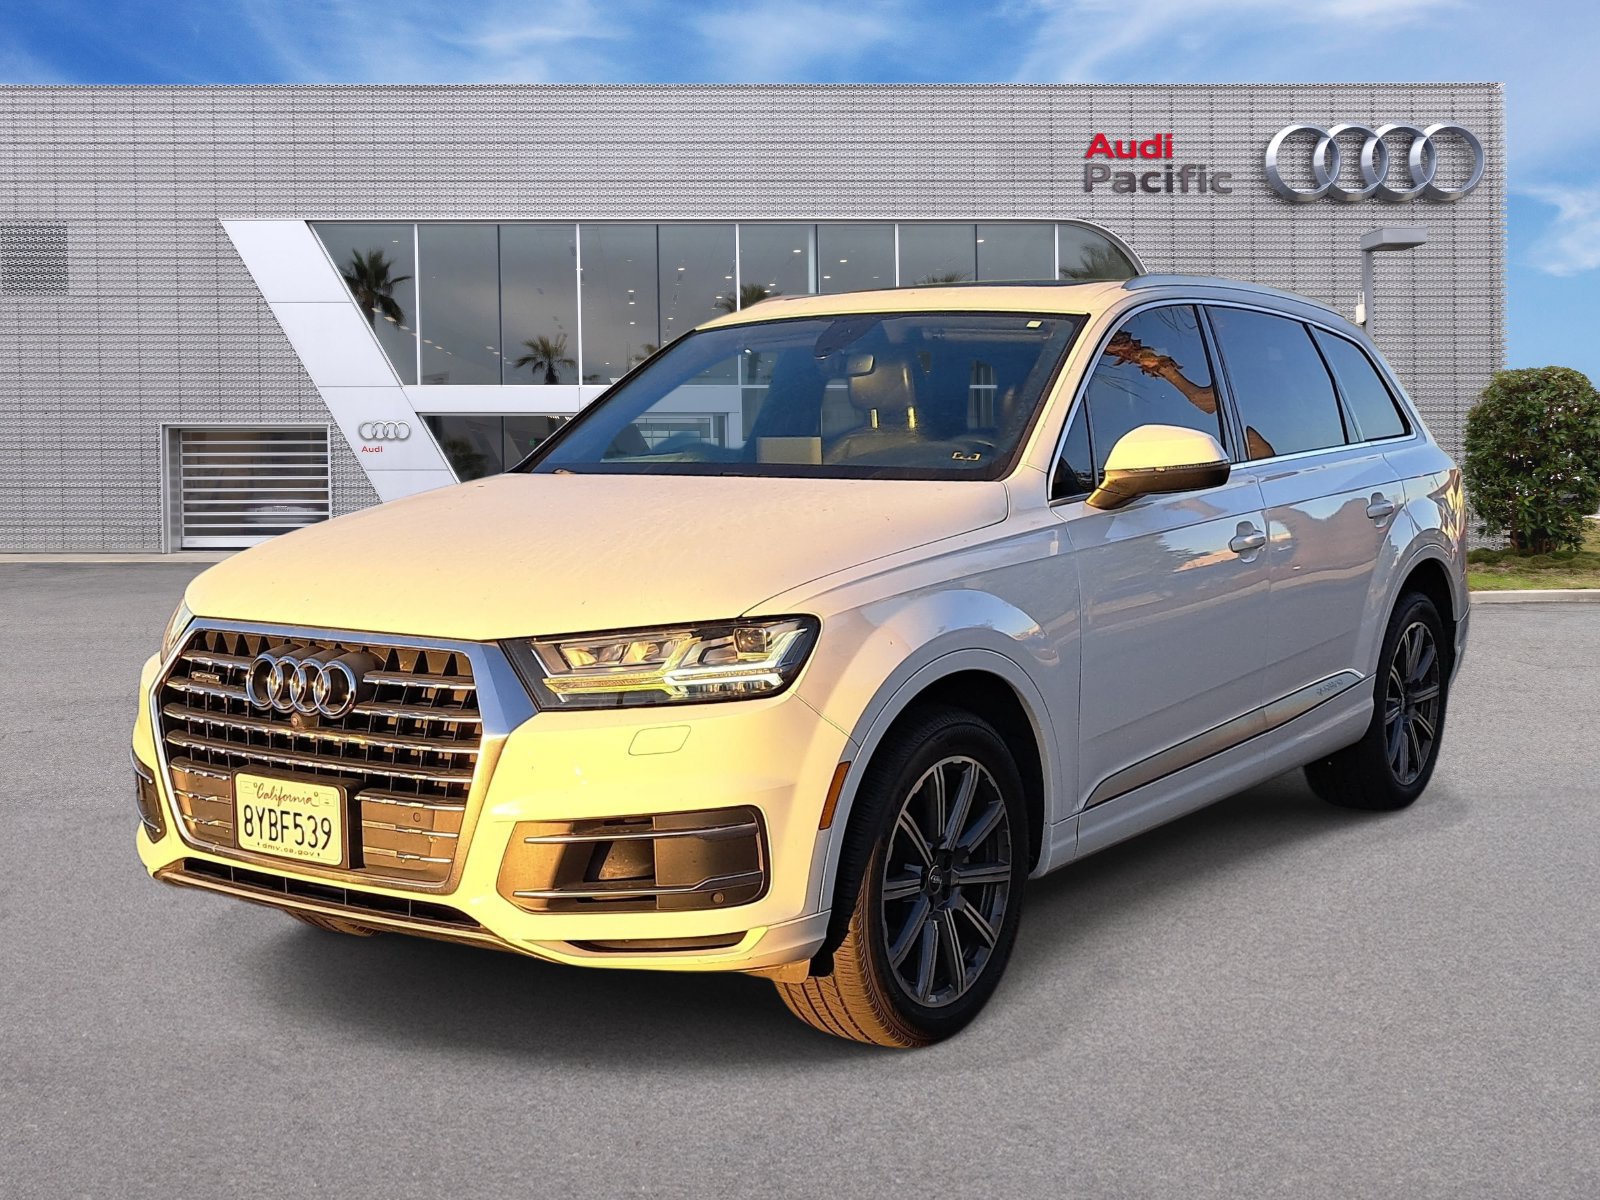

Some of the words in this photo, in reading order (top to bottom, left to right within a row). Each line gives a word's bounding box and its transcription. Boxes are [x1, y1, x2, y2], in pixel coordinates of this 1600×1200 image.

[1084, 133, 1173, 159] Audi
[1084, 163, 1233, 193] Pacific
[361, 445, 383, 453] Audi
[256, 782, 319, 807] California
[243, 804, 332, 850] 8YBF539
[262, 843, 315, 857] dmv.ca.gov
